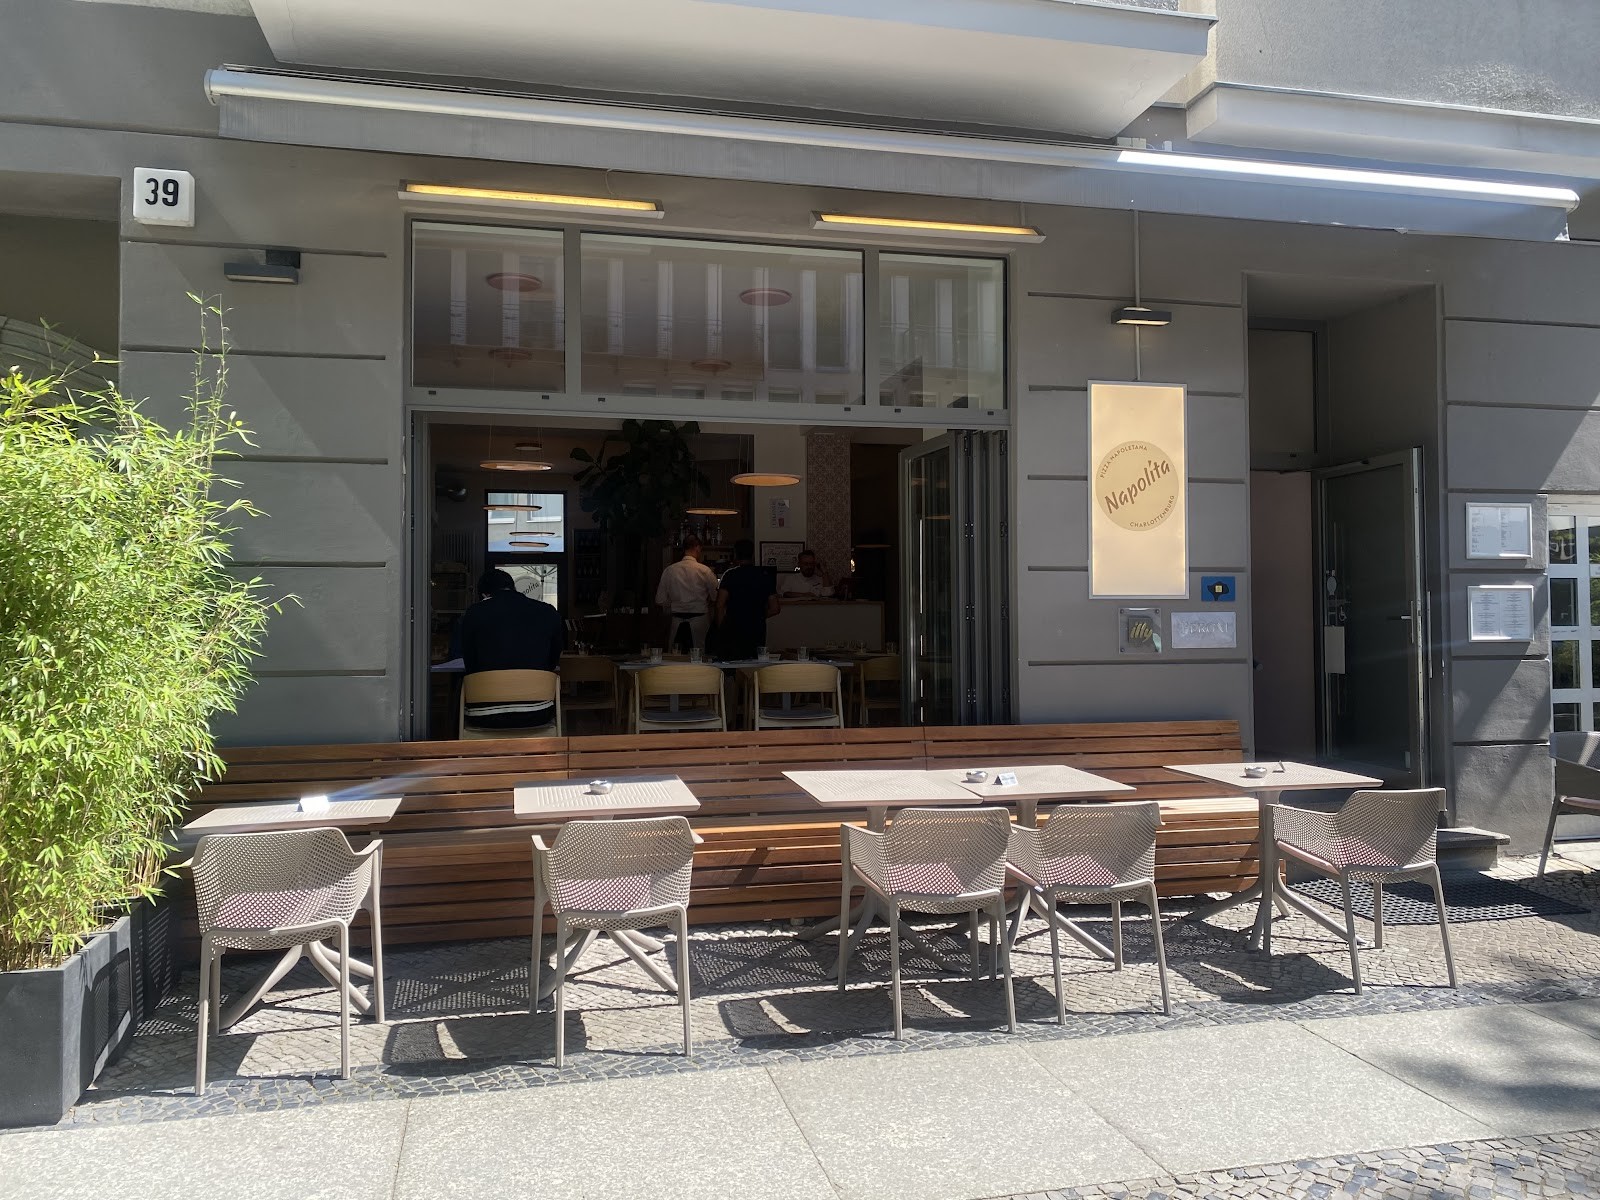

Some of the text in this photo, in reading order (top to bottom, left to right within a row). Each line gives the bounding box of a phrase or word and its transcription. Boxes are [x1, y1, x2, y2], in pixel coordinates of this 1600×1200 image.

[145, 177, 179, 206] 39
[1104, 460, 1170, 514] Napolita
[1129, 495, 1175, 528] CHARLOTTENBURG
